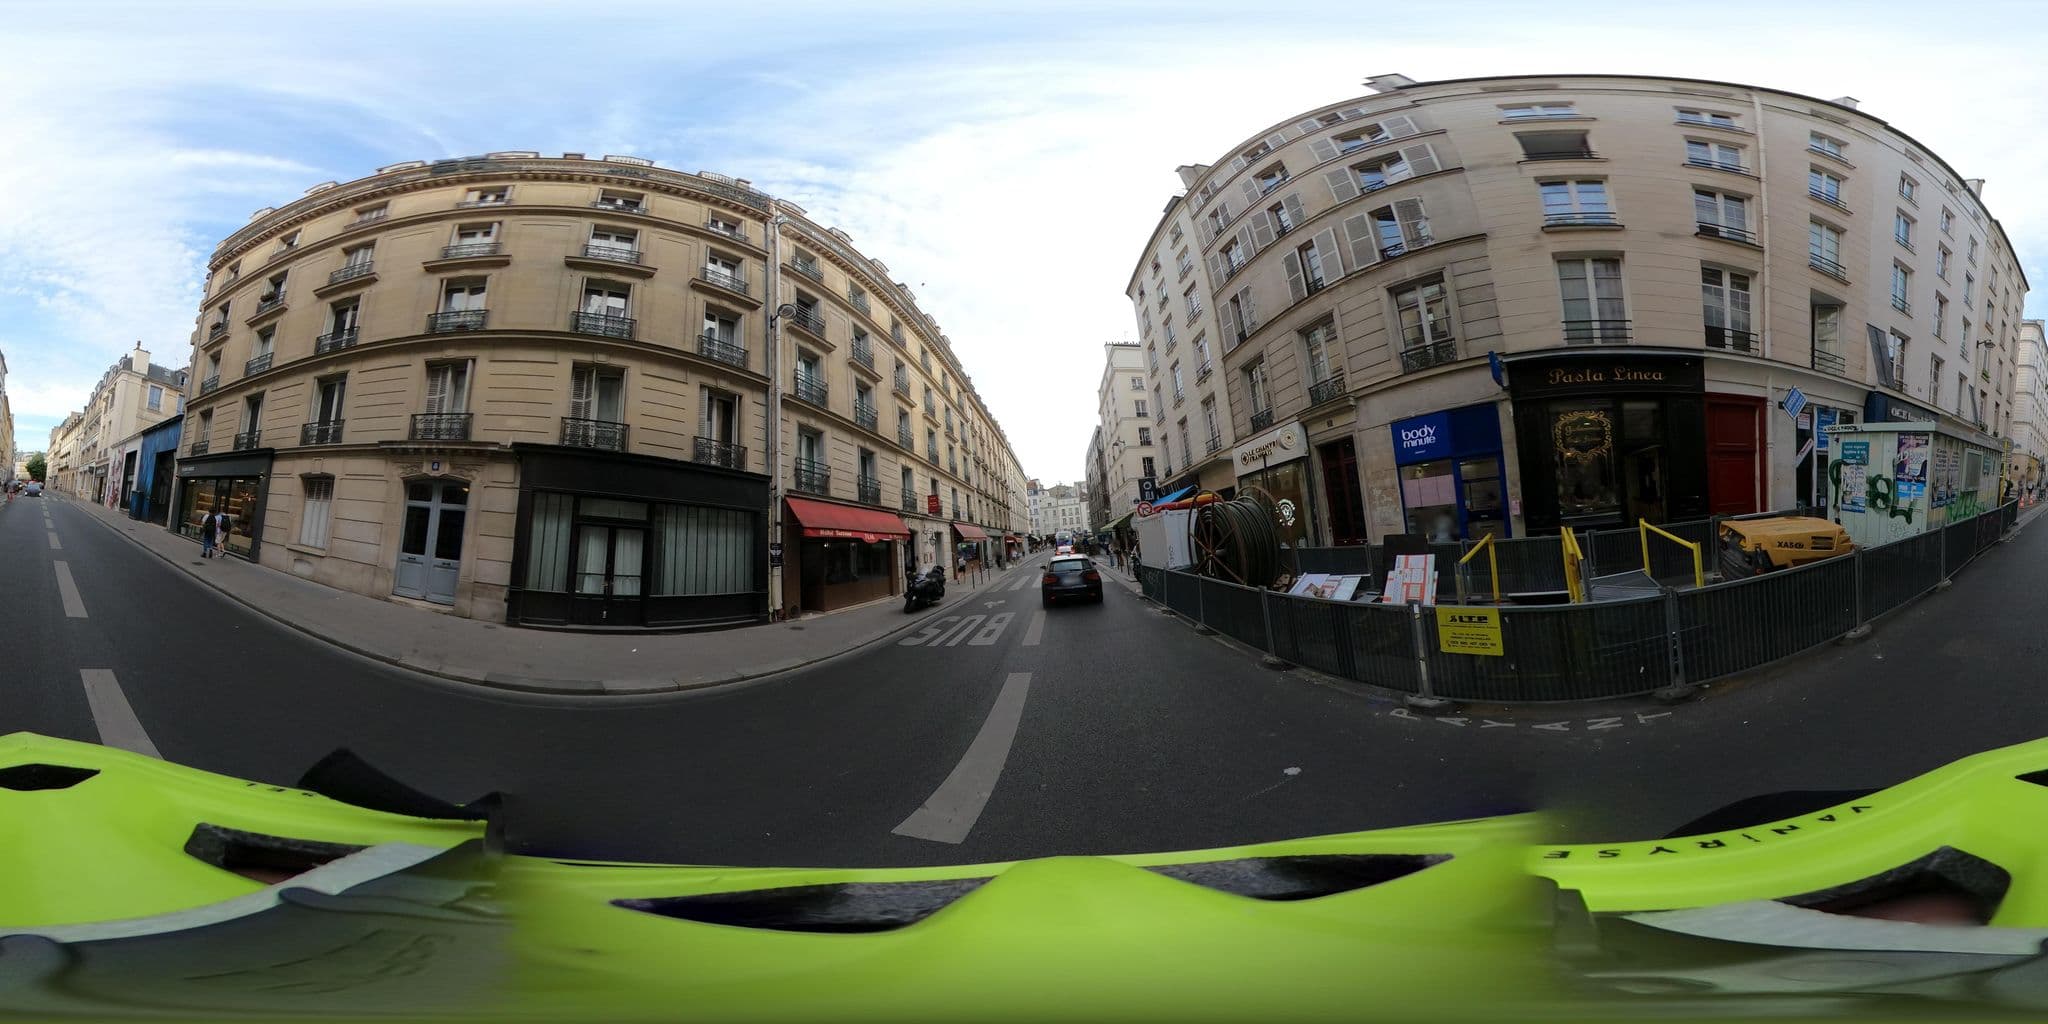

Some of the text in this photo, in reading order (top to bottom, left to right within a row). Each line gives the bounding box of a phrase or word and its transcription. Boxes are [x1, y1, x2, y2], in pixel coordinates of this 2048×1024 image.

[1549, 367, 1664, 384] Pasta Linea
[1402, 424, 1436, 440] body
[1403, 435, 1436, 448] minute
[898, 612, 1016, 646] BUS
[1390, 708, 1672, 731] PAYANT
